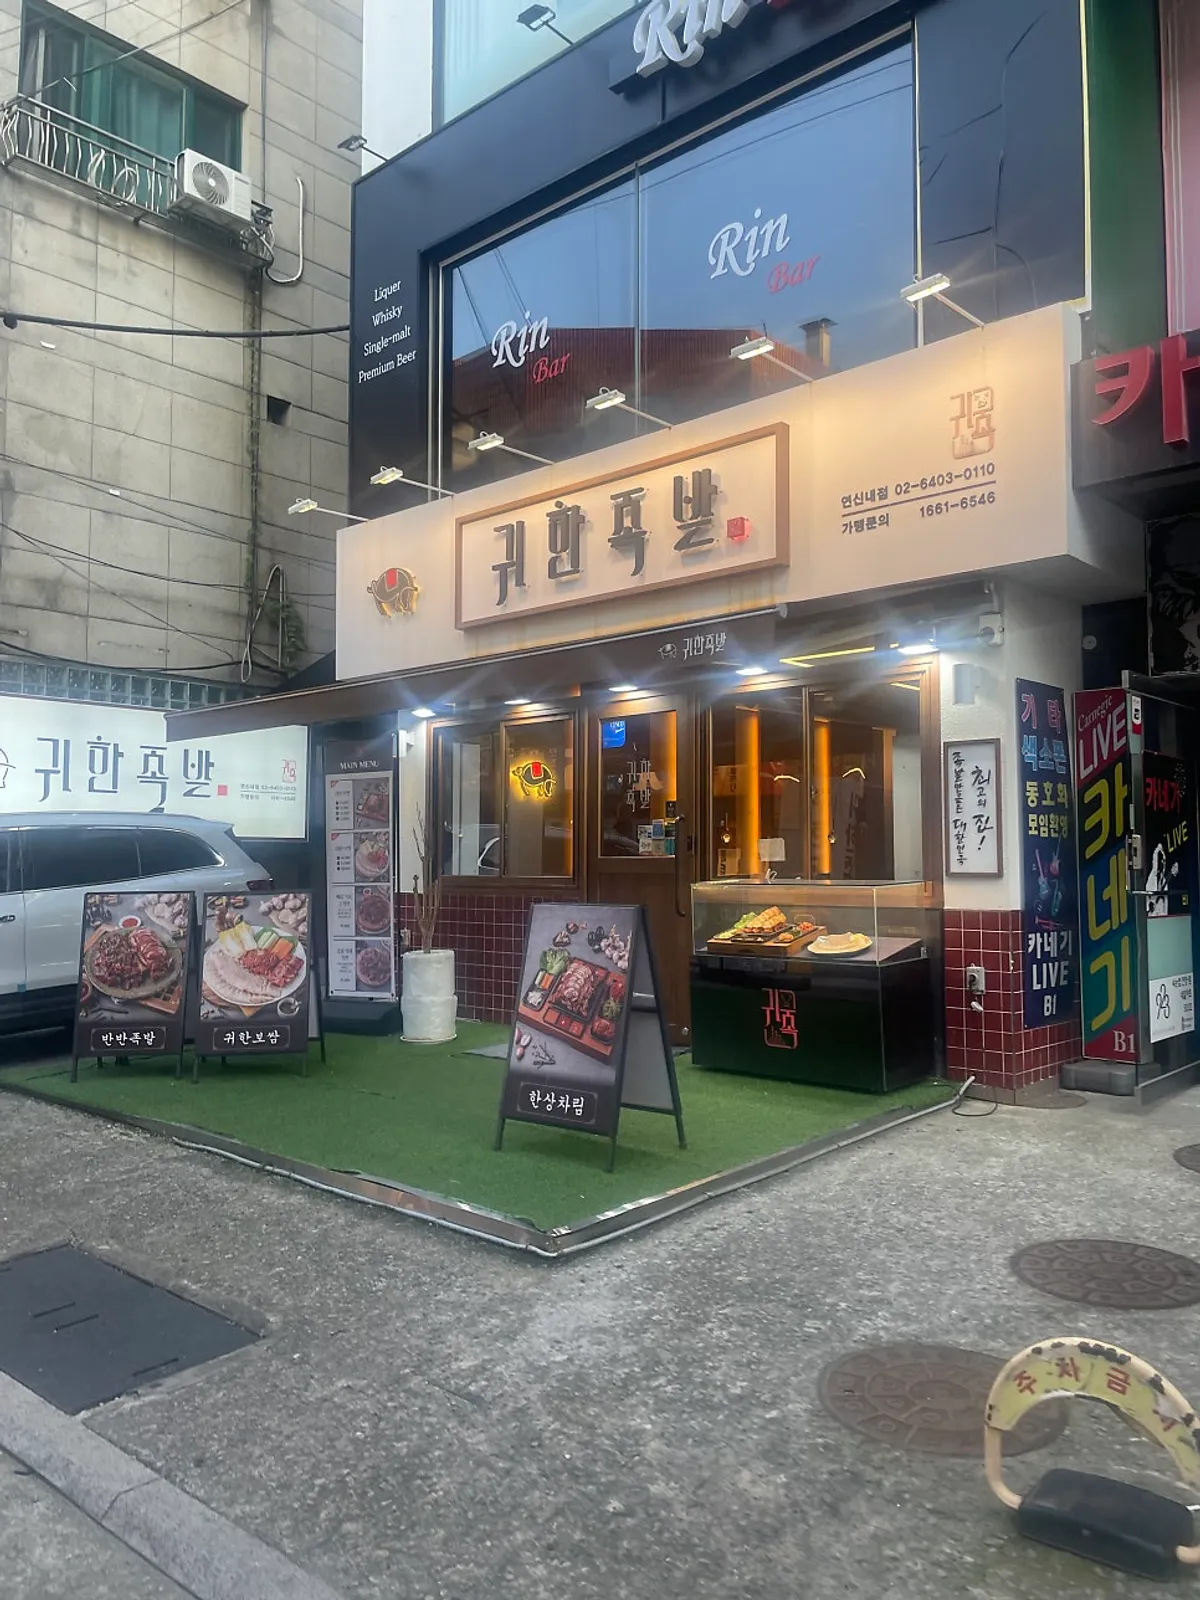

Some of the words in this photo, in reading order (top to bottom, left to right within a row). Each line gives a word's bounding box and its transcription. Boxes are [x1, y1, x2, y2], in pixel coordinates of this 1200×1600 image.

[708, 208, 790, 280] Rin
[767, 254, 821, 294] Bar
[373, 280, 402, 302] Liquer
[372, 305, 403, 327] Whisky
[363, 324, 412, 357] Single-malt
[491, 310, 550, 369] Rin
[358, 360, 395, 384] Premium
[396, 350, 417, 367] Beer
[533, 353, 570, 384] Bar
[841, 485, 889, 510] 연신내점
[894, 461, 996, 496] 02-6403-0110
[841, 513, 890, 535] 가맹문의
[919, 490, 996, 518] 1661-6546
[491, 468, 722, 607] 귀한족발
[682, 632, 727, 661] 귀한족발
[1021, 734, 1068, 775] 색소폰
[1079, 701, 1127, 779] LIVE
[34, 735, 216, 813] 귀한족발
[971, 765, 991, 808] 최고의
[1025, 780, 1069, 809] 동호회
[1028, 812, 1069, 839] 모임환영
[1166, 820, 1189, 854] LIVE
[1083, 761, 1131, 1032] 카네기
[1027, 930, 1073, 959] 카네기
[1032, 960, 1069, 990] LIVE
[1043, 994, 1057, 1017] B1
[223, 1029, 281, 1047] 귀한보쌈
[1113, 1029, 1137, 1054] B1
[528, 1089, 585, 1116] 한상차림
